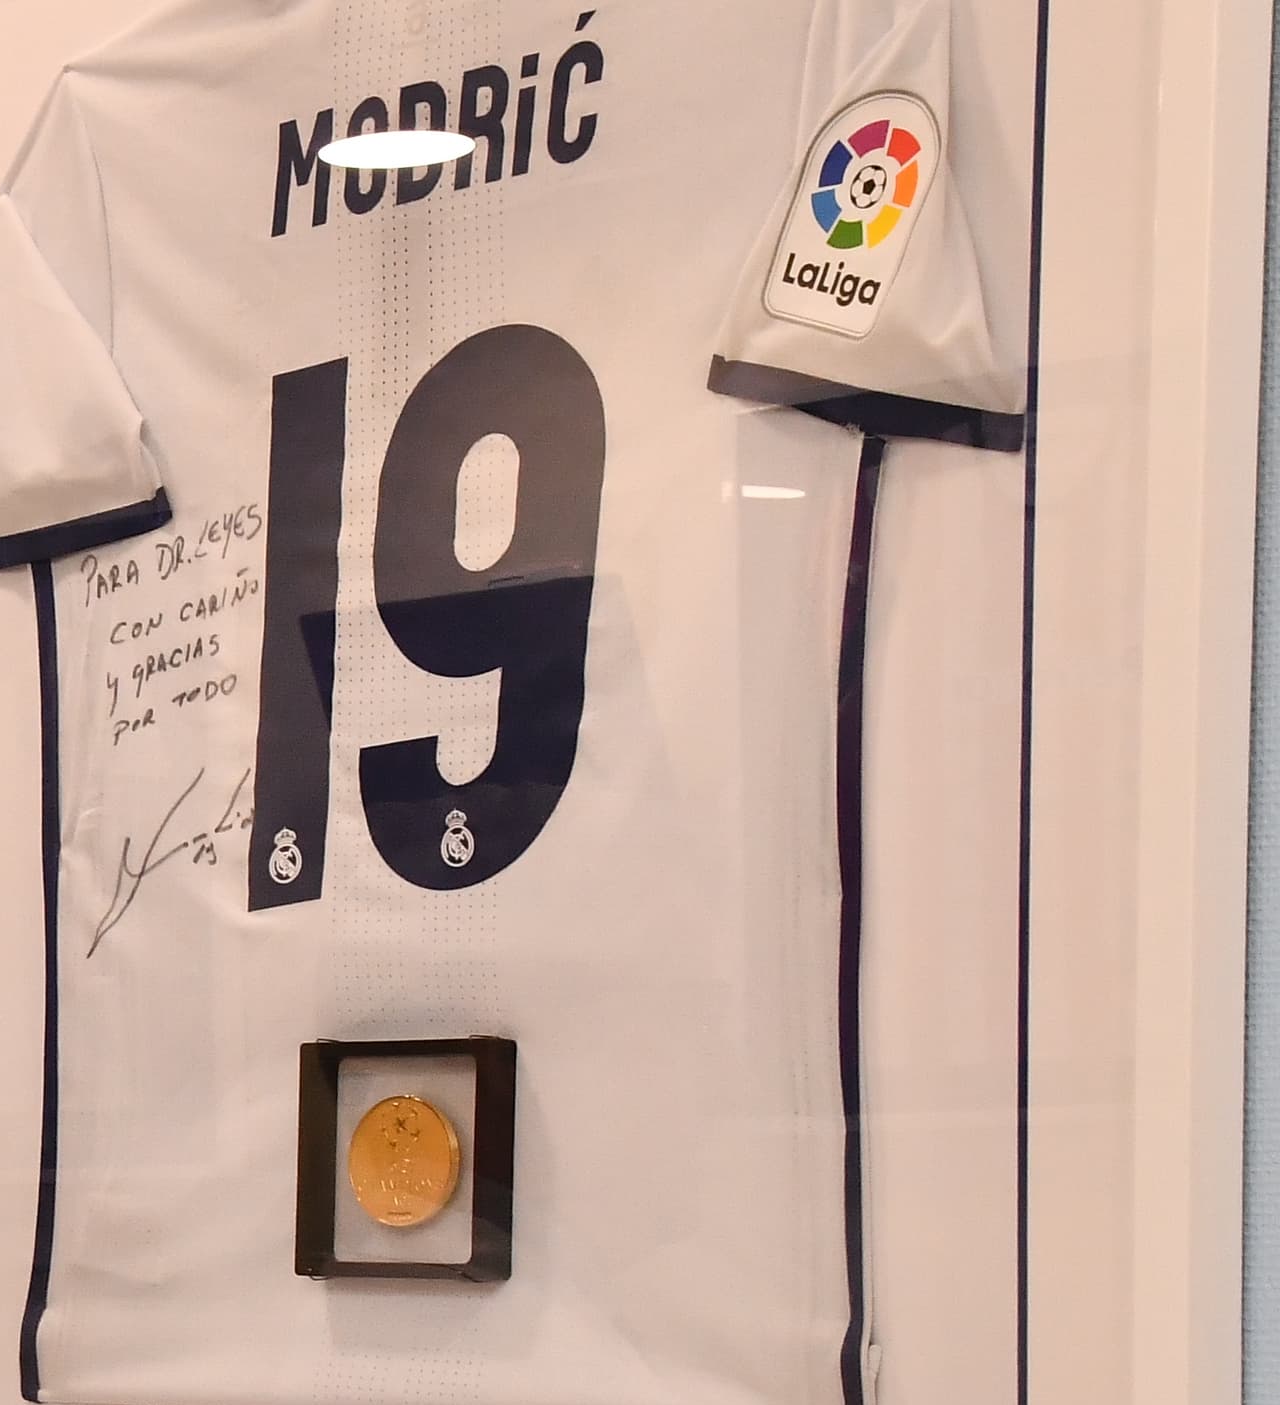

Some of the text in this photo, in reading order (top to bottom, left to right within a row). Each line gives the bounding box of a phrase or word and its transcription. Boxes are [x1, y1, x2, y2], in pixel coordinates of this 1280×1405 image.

[782, 252, 882, 307] LaLiga
[80, 553, 140, 608] PARA
[194, 503, 263, 560] LEYES
[109, 613, 163, 645] CON
[248, 323, 606, 913] 19
